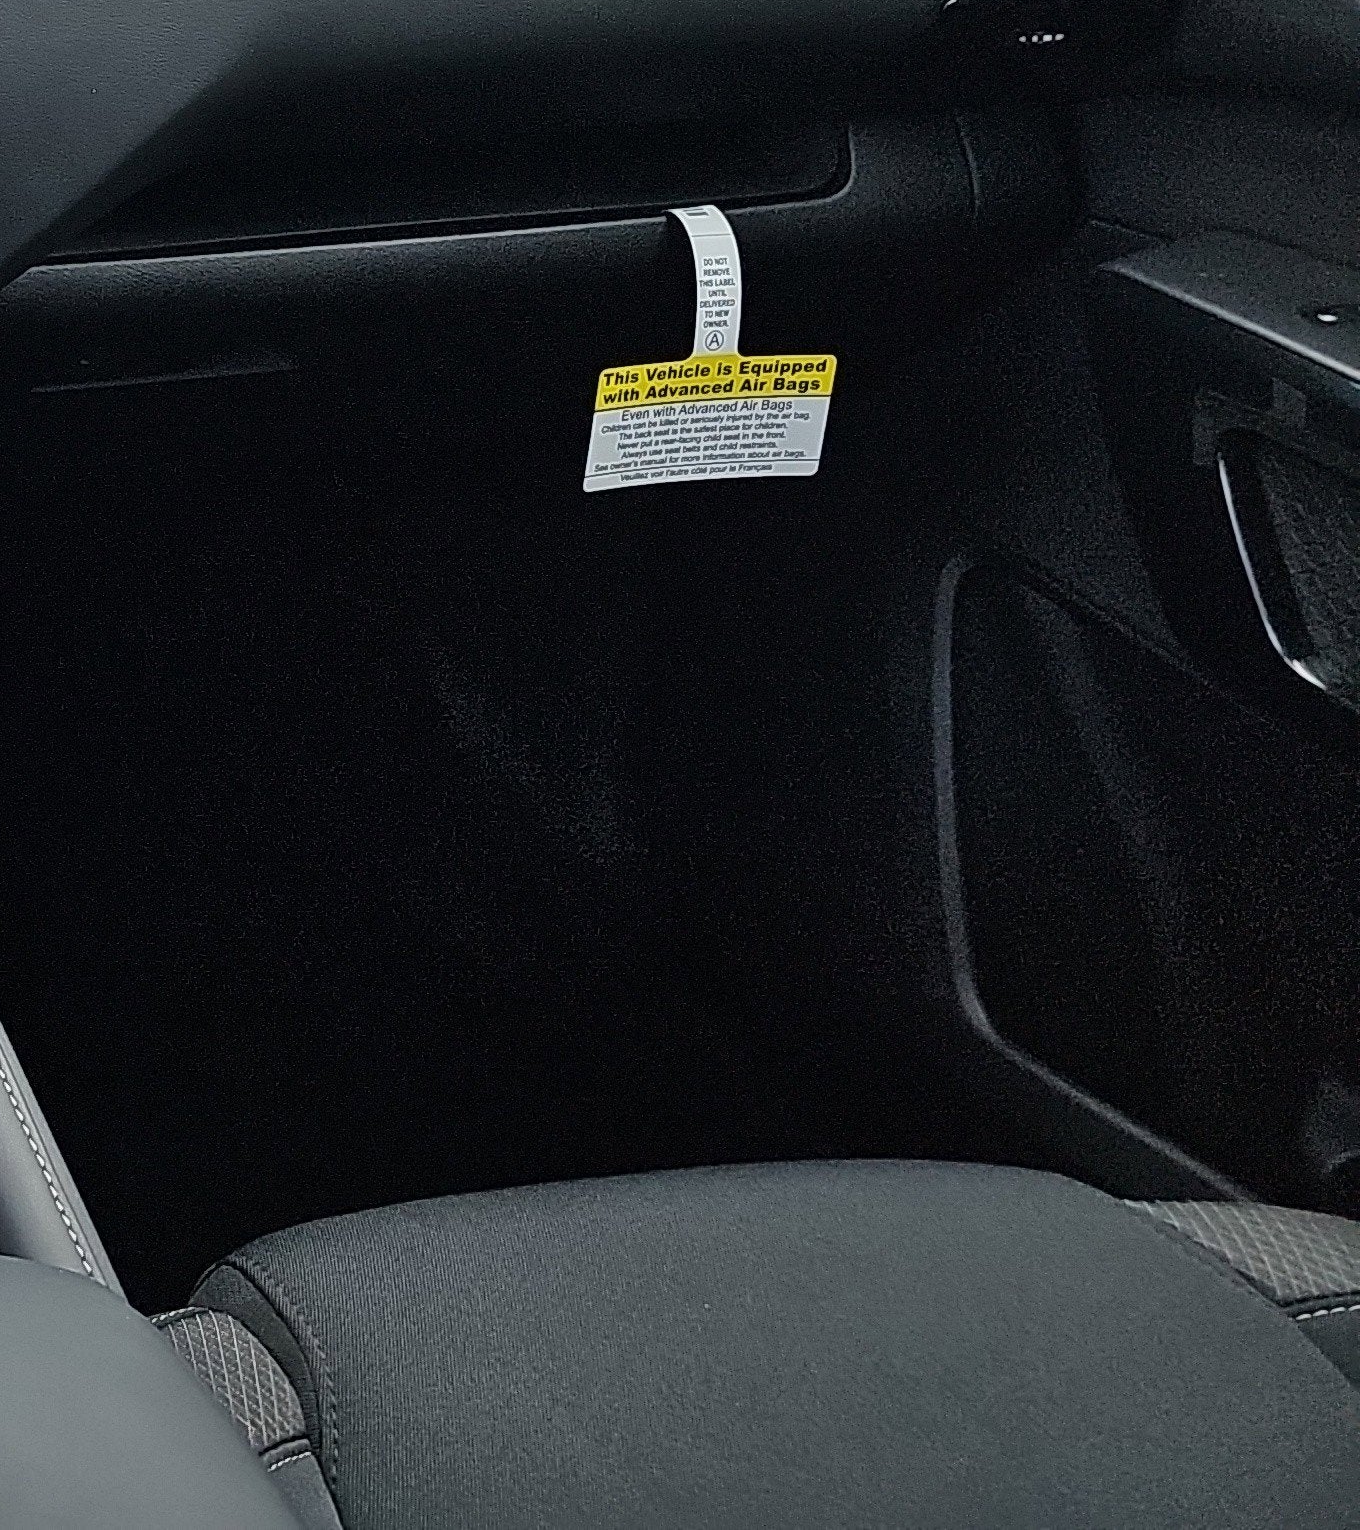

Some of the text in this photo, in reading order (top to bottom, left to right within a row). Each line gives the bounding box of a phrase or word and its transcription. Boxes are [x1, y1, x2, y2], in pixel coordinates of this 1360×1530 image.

[703, 257, 728, 266] DO NOT
[703, 268, 730, 276] REMOVE
[699, 278, 736, 288] THIS LABEL
[708, 289, 728, 298] UNTIL
[699, 299, 736, 309] DELIVERED
[705, 310, 730, 319] TO NEW
[603, 359, 828, 387] This Vehicle is Equipped
[603, 377, 821, 405] with Advanced Air Bags
[621, 399, 793, 422] Even with Advanced Air Bags
